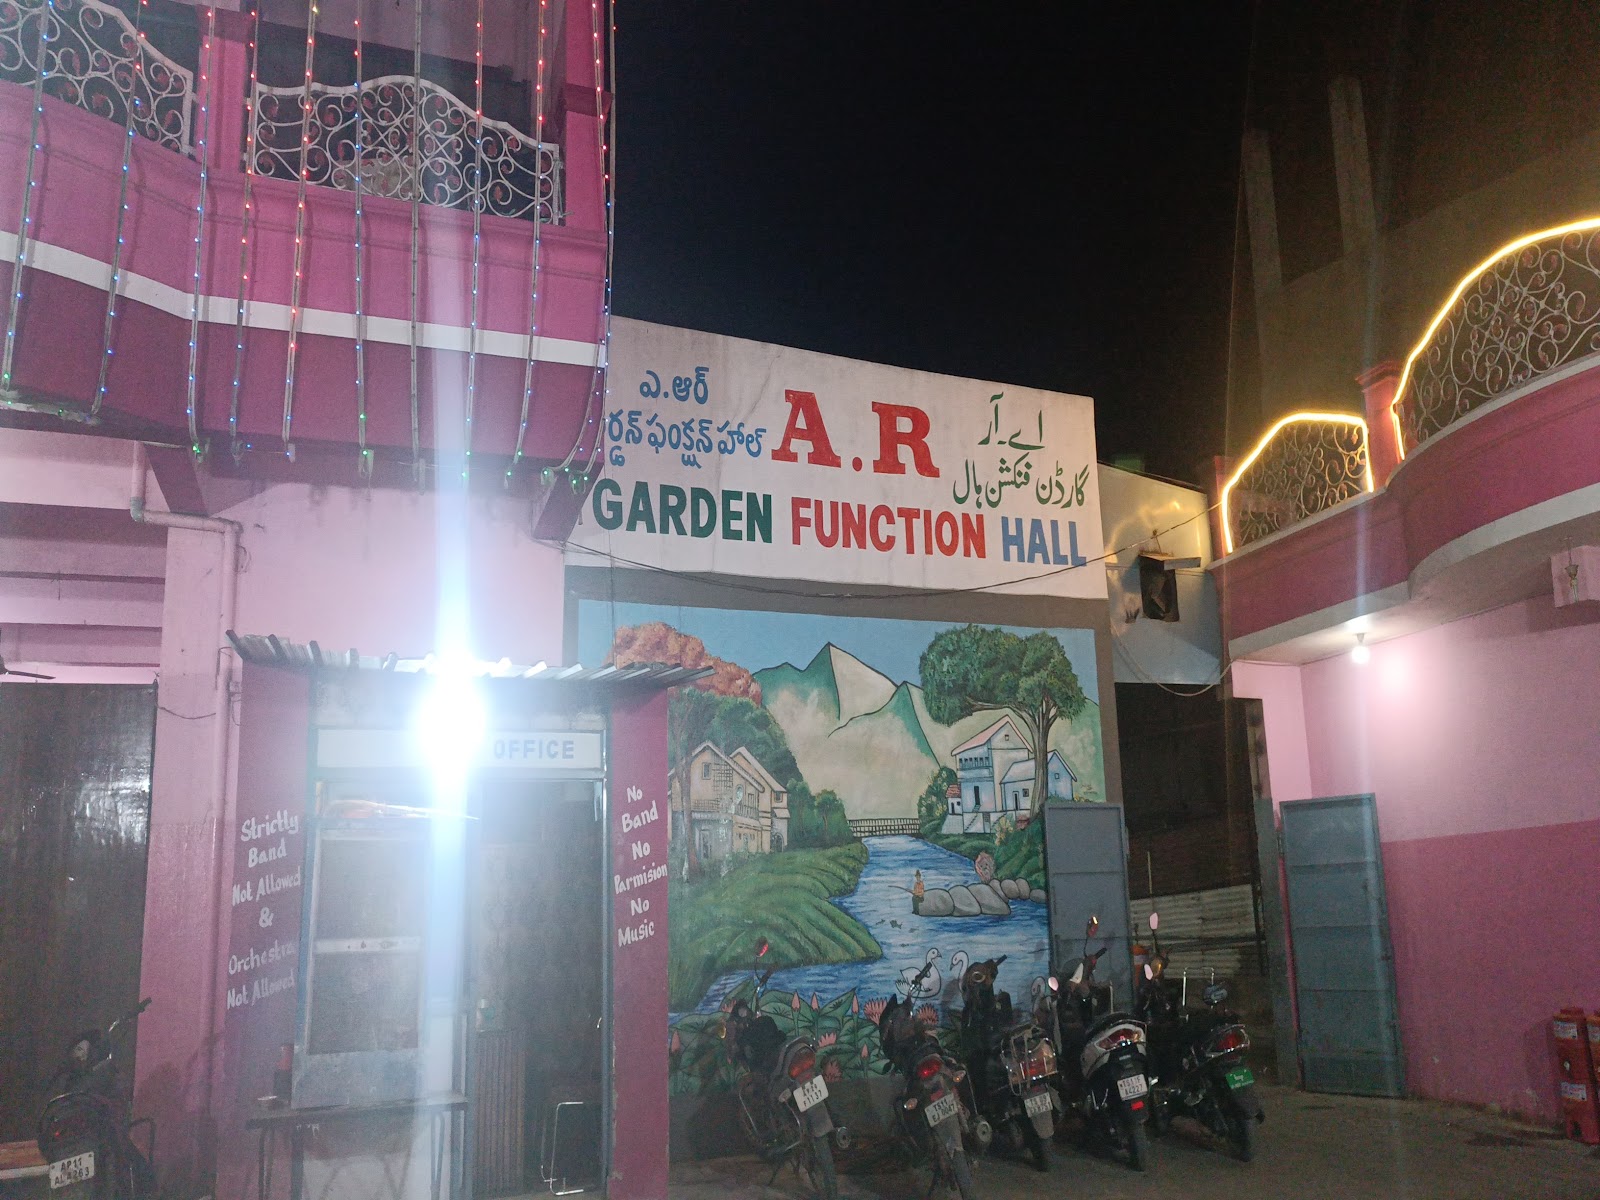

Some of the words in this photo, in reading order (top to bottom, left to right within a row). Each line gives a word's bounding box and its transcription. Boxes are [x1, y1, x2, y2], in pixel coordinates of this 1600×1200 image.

[771, 389, 940, 478] A.R
[592, 478, 773, 543] GARDEN
[791, 496, 986, 559] FUNCTION
[1001, 516, 1087, 567] HALL
[494, 740, 575, 760] OFFICE
[626, 785, 643, 803] No
[240, 809, 299, 841] Strictly
[621, 800, 659, 833] Band
[248, 837, 287, 868] Band
[632, 840, 651, 860] No
[232, 880, 253, 907] Not
[256, 865, 301, 902] Allowed
[259, 907, 274, 928] &
[630, 898, 649, 916] No
[617, 919, 655, 947] Music
[227, 984, 249, 1010] Not
